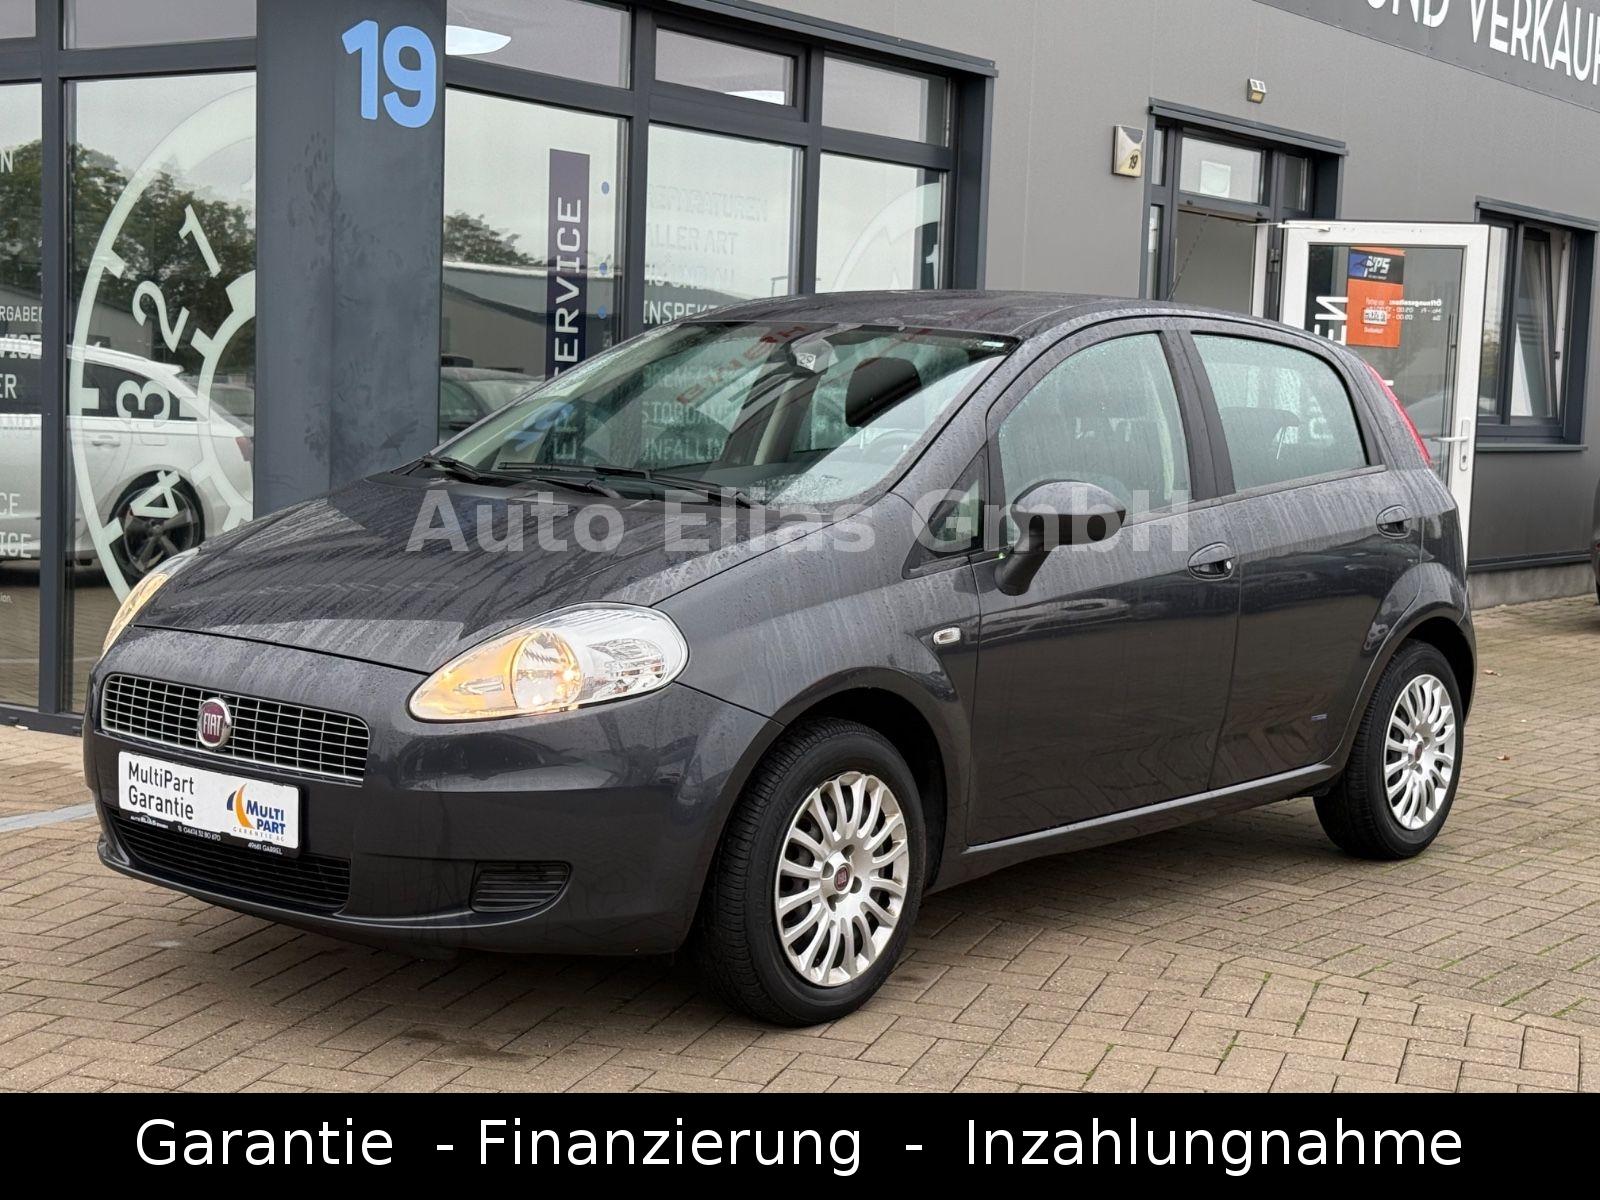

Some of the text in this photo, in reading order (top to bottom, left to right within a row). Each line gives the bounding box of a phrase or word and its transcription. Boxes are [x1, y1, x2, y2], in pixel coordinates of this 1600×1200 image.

[341, 20, 436, 128] 19
[1128, 153, 1139, 170] 19
[554, 196, 582, 376] ERVICE
[132, 280, 189, 352] 2
[116, 380, 171, 429] 3
[130, 470, 181, 519] 4
[203, 712, 223, 737] FIAT
[128, 760, 195, 795] MultiPart
[128, 785, 194, 821] Garantie
[256, 818, 286, 835] PART
